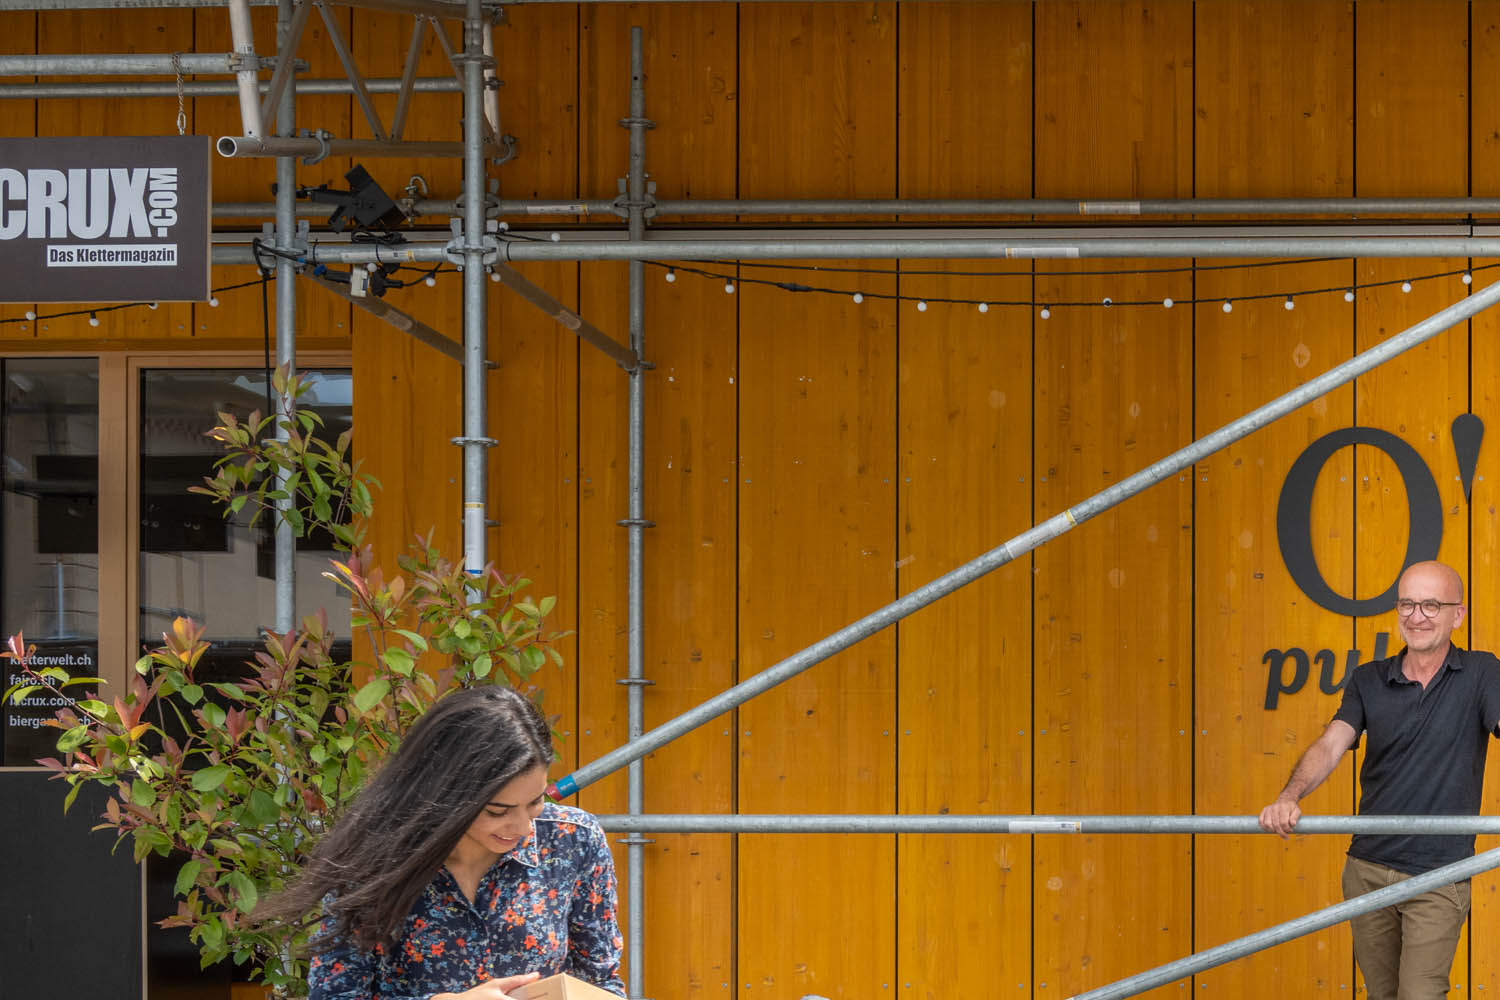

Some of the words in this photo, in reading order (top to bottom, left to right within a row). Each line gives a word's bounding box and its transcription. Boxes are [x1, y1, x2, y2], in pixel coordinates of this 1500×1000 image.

[0, 168, 152, 240] CRUX
[50, 248, 74, 263] Das
[76, 247, 176, 265] Klettermagazin
